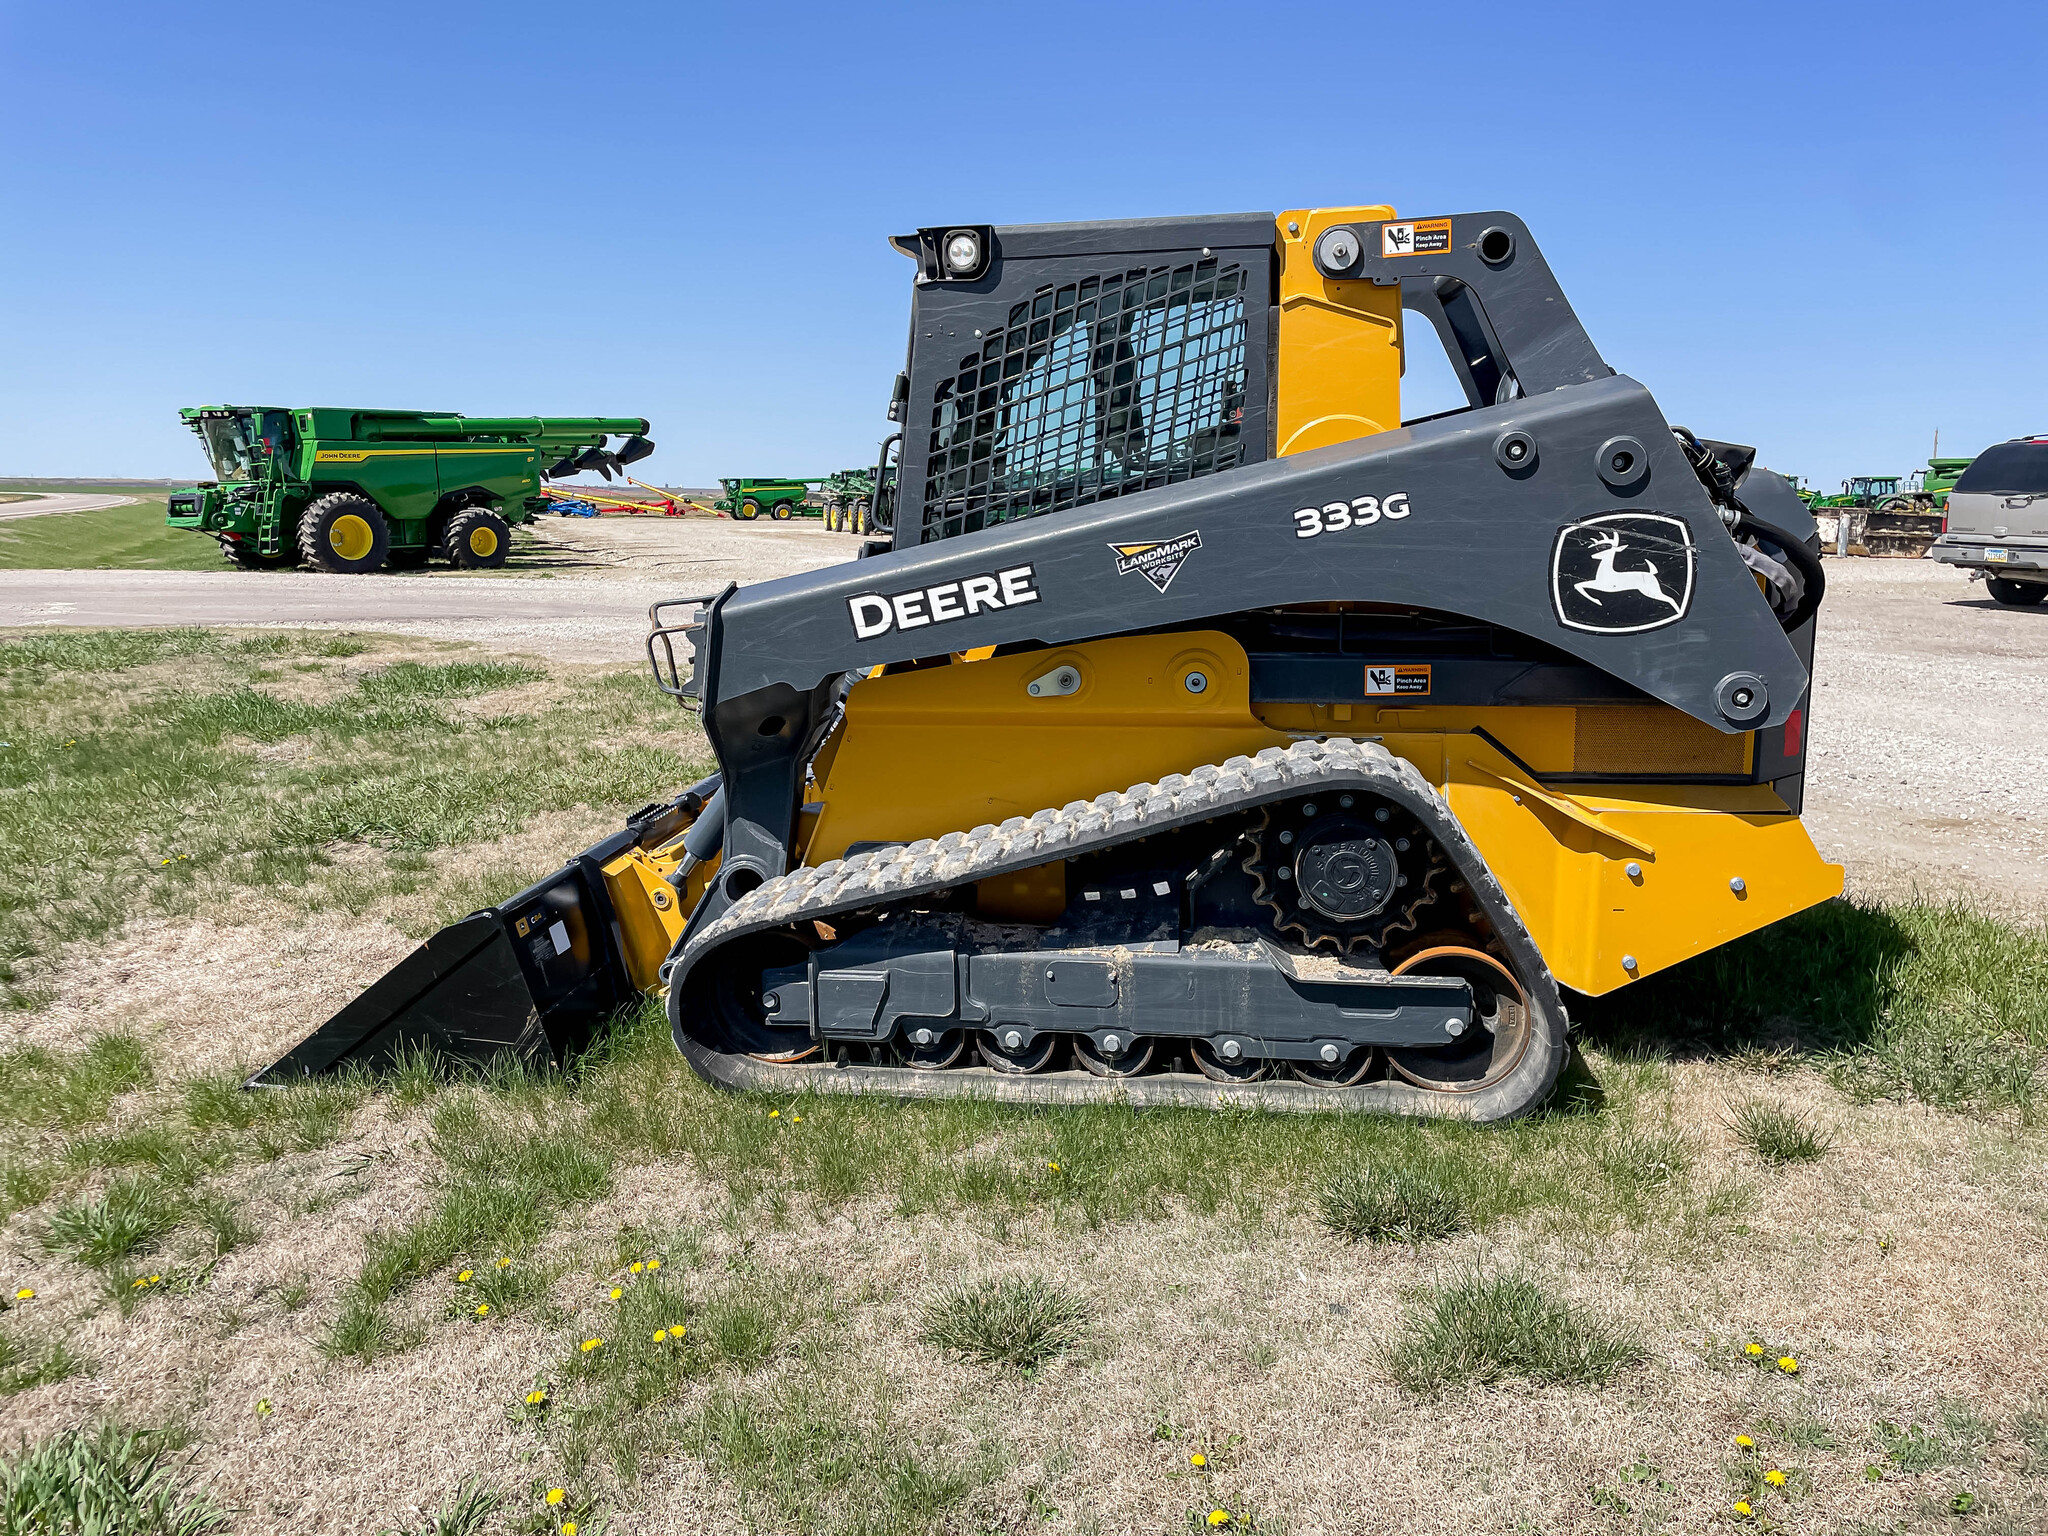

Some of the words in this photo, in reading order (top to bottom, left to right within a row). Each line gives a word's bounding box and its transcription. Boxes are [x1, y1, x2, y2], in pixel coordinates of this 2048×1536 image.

[1415, 234, 1432, 242] Pinch
[1293, 492, 1411, 538] 333G
[1121, 536, 1198, 570] LANDMARK
[1141, 551, 1184, 570] WORKSITE
[849, 565, 1038, 639] DEERE
